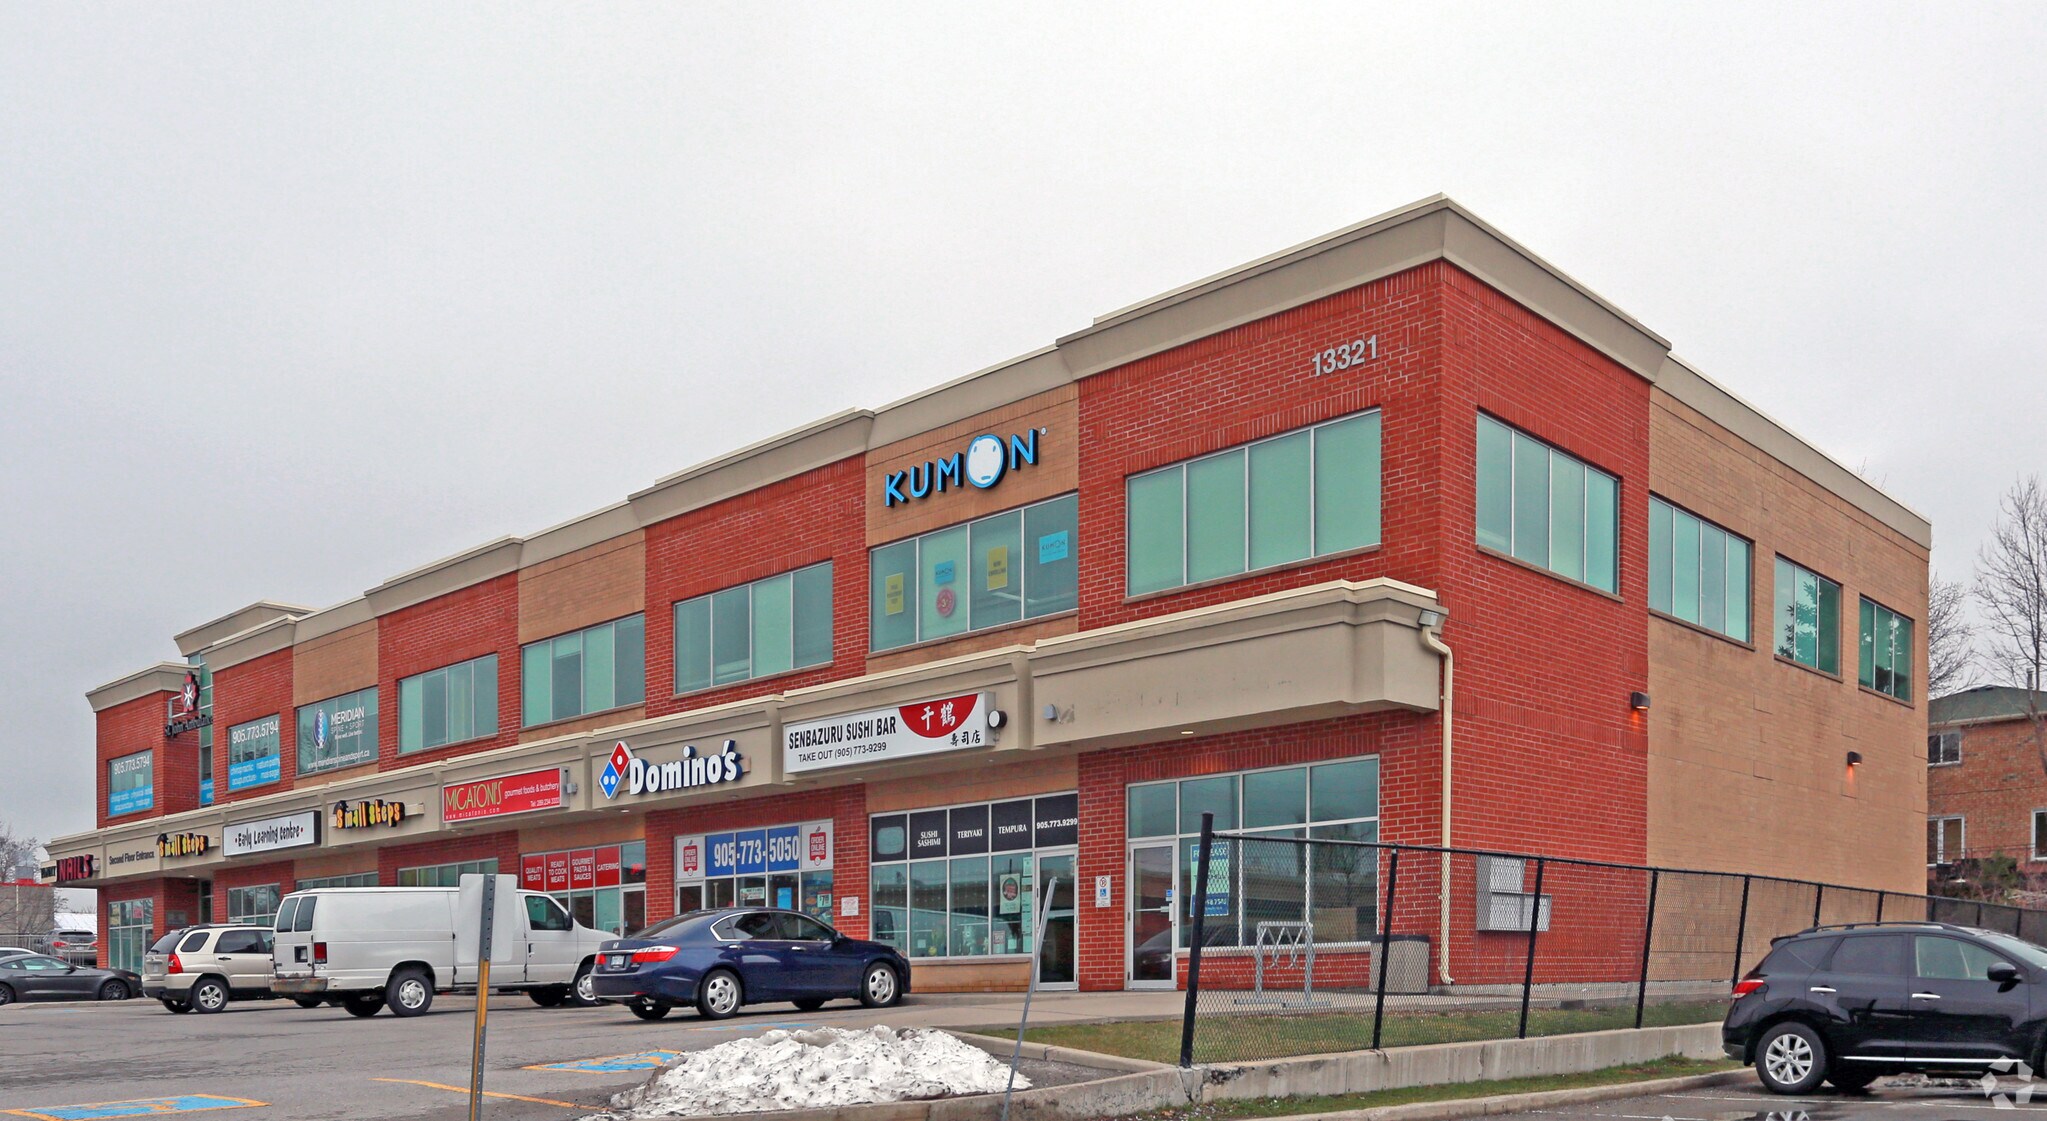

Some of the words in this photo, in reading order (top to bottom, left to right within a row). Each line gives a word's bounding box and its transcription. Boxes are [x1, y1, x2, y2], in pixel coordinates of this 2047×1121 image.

[1311, 334, 1377, 377] 13321
[330, 706, 365, 726] MERIDIAN
[232, 720, 279, 744] 905.773.5794
[788, 724, 843, 750] SENBAZURU
[846, 719, 874, 741] SUSHI
[876, 715, 897, 735] BAR
[798, 752, 816, 763] TAKE
[817, 749, 832, 760] OUT
[834, 746, 853, 759] (905)
[853, 741, 887, 755] 773-9299
[629, 740, 741, 795] Domino's
[445, 780, 503, 812] MICATONI'S
[998, 824, 1027, 834] TEMPURA
[1036, 817, 1078, 830] 905.773.9299
[238, 827, 252, 850] Early
[920, 830, 938, 840] SUSHI
[957, 828, 983, 839] TERIYAKI
[917, 837, 941, 848] SASHIMI
[109, 854, 125, 866] Second
[124, 852, 136, 864] Floor
[135, 850, 155, 862] Entrance
[572, 857, 593, 866] GOURMET
[56, 854, 93, 882] NAILS
[550, 860, 565, 868] READY
[596, 862, 619, 872] CATERING
[525, 866, 543, 874] QUALITY
[554, 867, 567, 875] COOK
[527, 874, 541, 882] MEATS
[550, 875, 565, 883] MEATS
[574, 872, 592, 881] SAUCES
